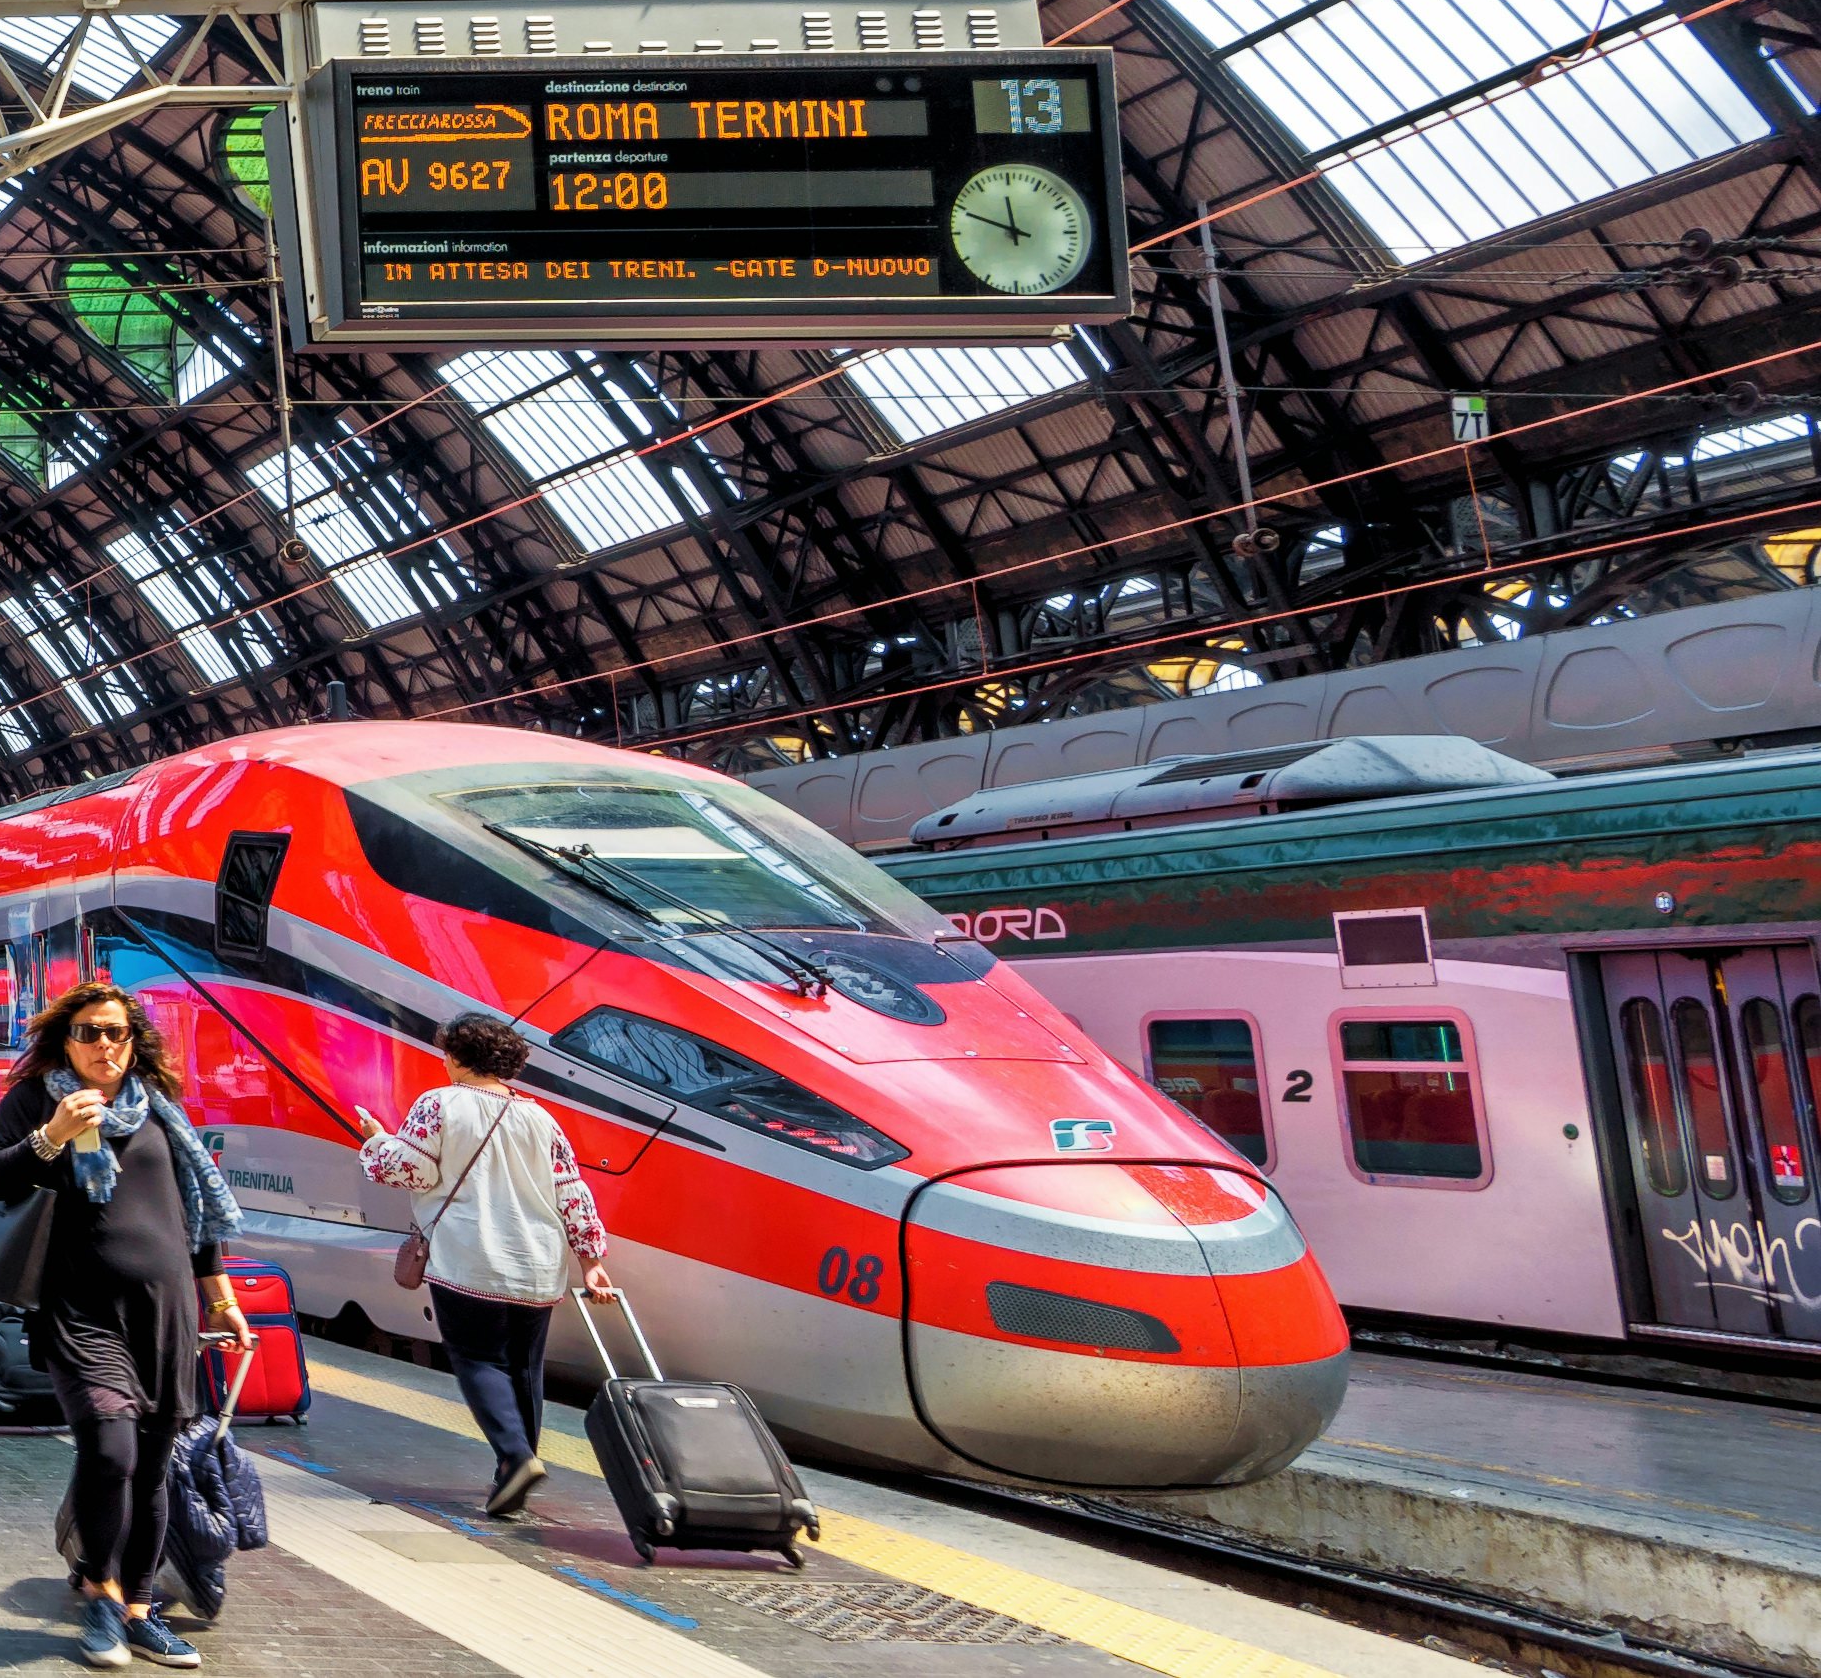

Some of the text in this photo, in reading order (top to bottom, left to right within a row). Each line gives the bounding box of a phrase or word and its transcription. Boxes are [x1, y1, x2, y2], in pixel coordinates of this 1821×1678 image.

[357, 85, 421, 96] treno train
[545, 80, 688, 93] destinazione destination
[1000, 80, 1062, 133] 13
[364, 113, 497, 130] FRECCIAROSSA
[548, 99, 868, 141] ROMA TERMINI
[549, 151, 668, 165] partenza departure
[361, 158, 511, 196] AV 9627
[551, 172, 668, 210] 12:00
[363, 240, 508, 253] informazioni information
[383, 263, 412, 281] IN
[429, 261, 528, 280] ATTESA
[545, 261, 591, 279] DEI
[1455, 412, 1484, 439] 7T
[1281, 1069, 1314, 1103] 2
[227, 1169, 294, 1194] TRENITALIA
[818, 1245, 884, 1305] 08
